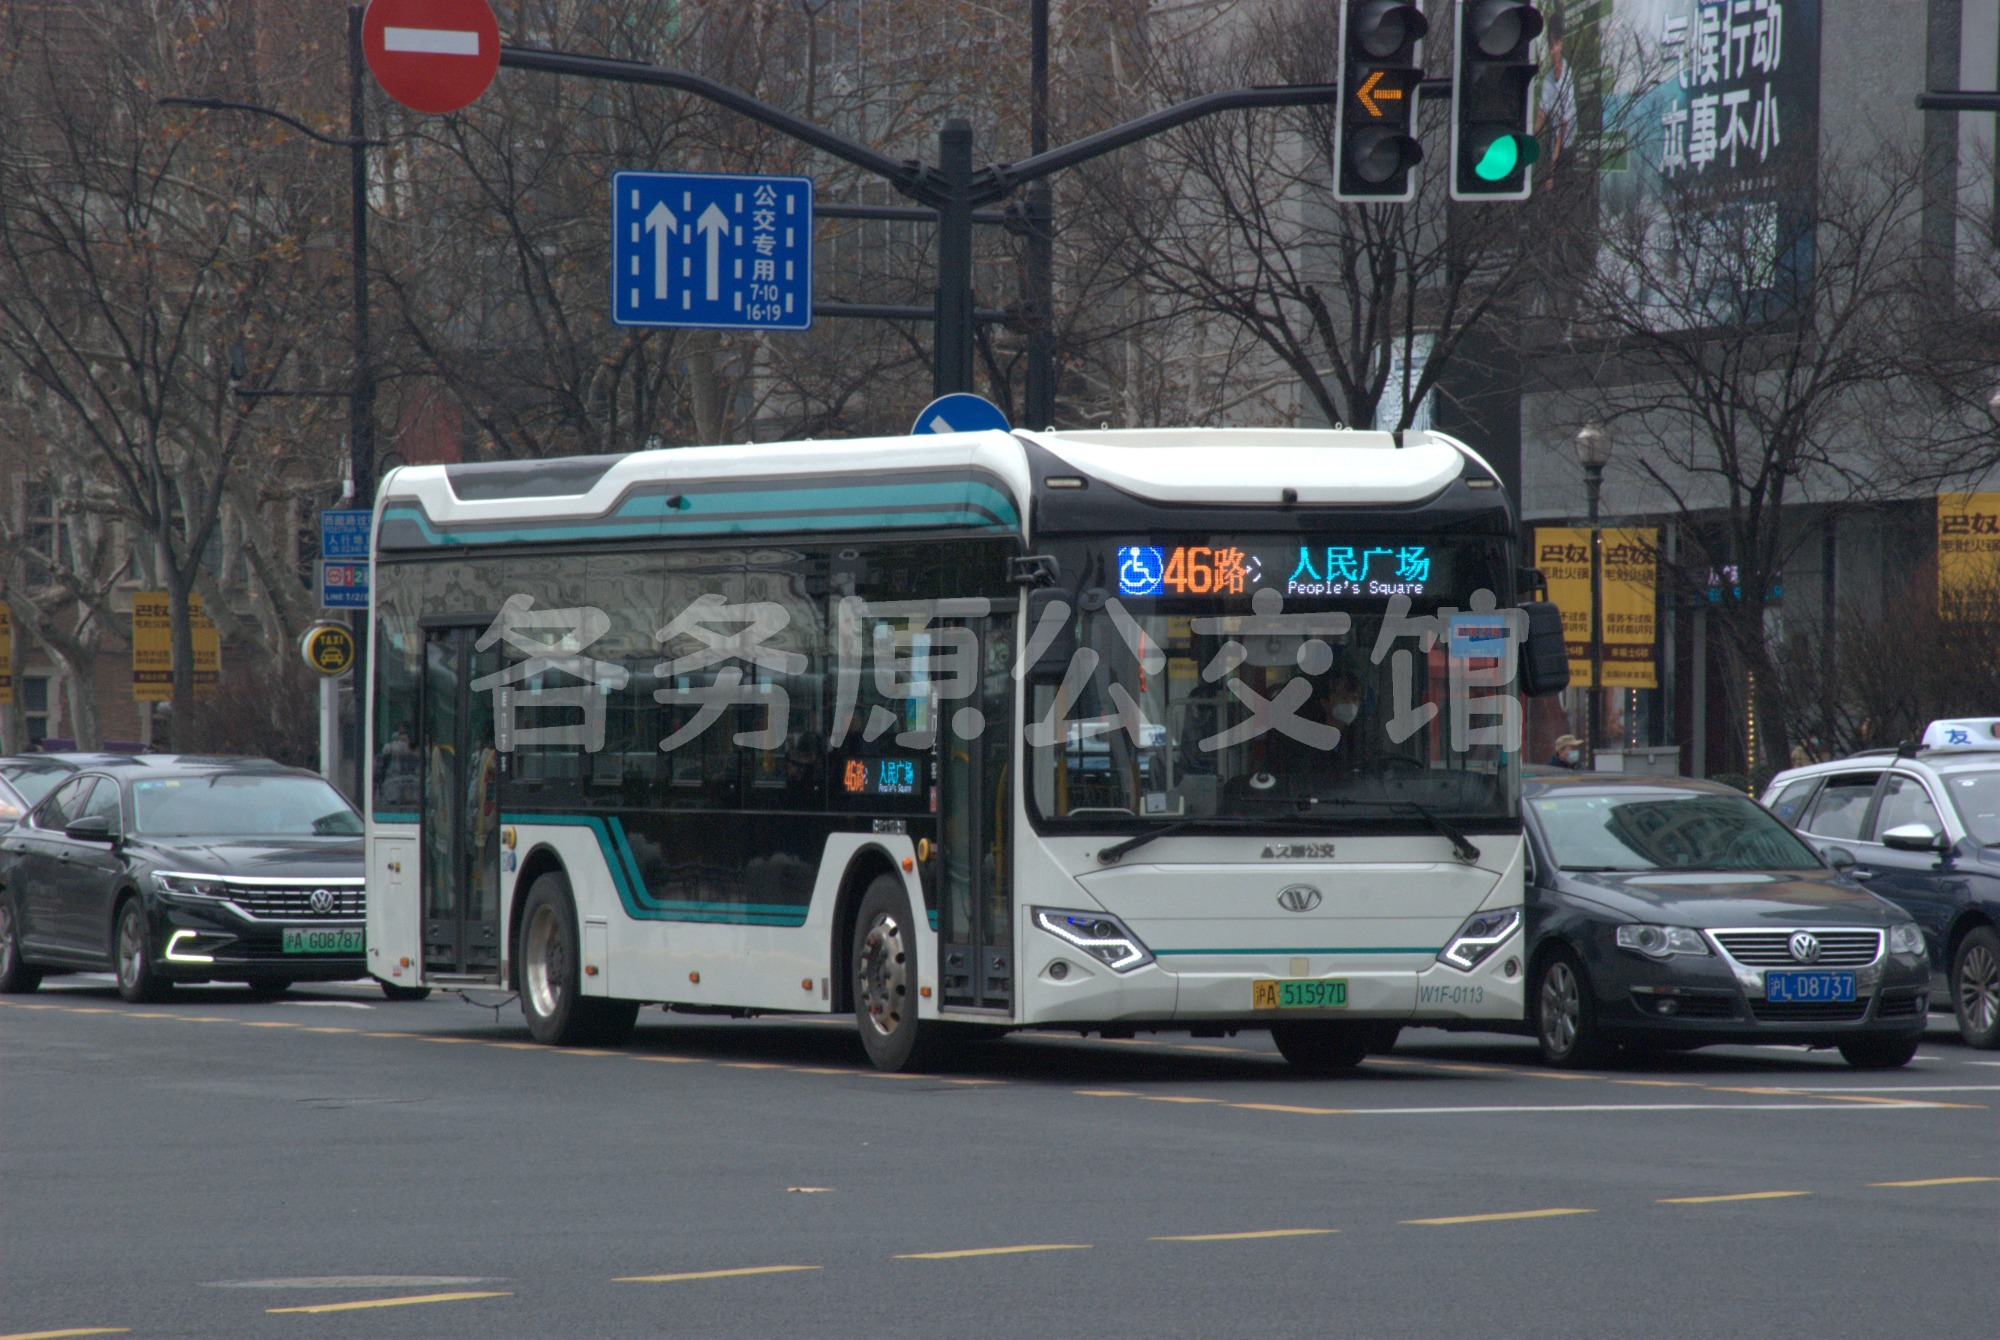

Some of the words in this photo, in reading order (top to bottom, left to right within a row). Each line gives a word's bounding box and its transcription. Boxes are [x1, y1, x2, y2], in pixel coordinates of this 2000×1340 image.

[1661, 0, 1782, 89] 气候行动
[1658, 82, 1780, 178] 本事不小
[752, 184, 778, 281] 公交专用
[750, 284, 779, 301] 7-10
[746, 304, 782, 321] 16-19
[1942, 512, 2000, 534] 巴奴
[1540, 544, 1589, 563] 巴奴
[1163, 547, 1249, 594] 46路
[1289, 547, 1430, 581] 人民广场
[325, 593, 344, 601] LINE
[1288, 581, 1361, 595] People's
[1369, 582, 1424, 595] Square
[320, 635, 344, 646] TAXI
[879, 761, 914, 785] 人民广场
[1420, 984, 1484, 1005] W1F-0113
